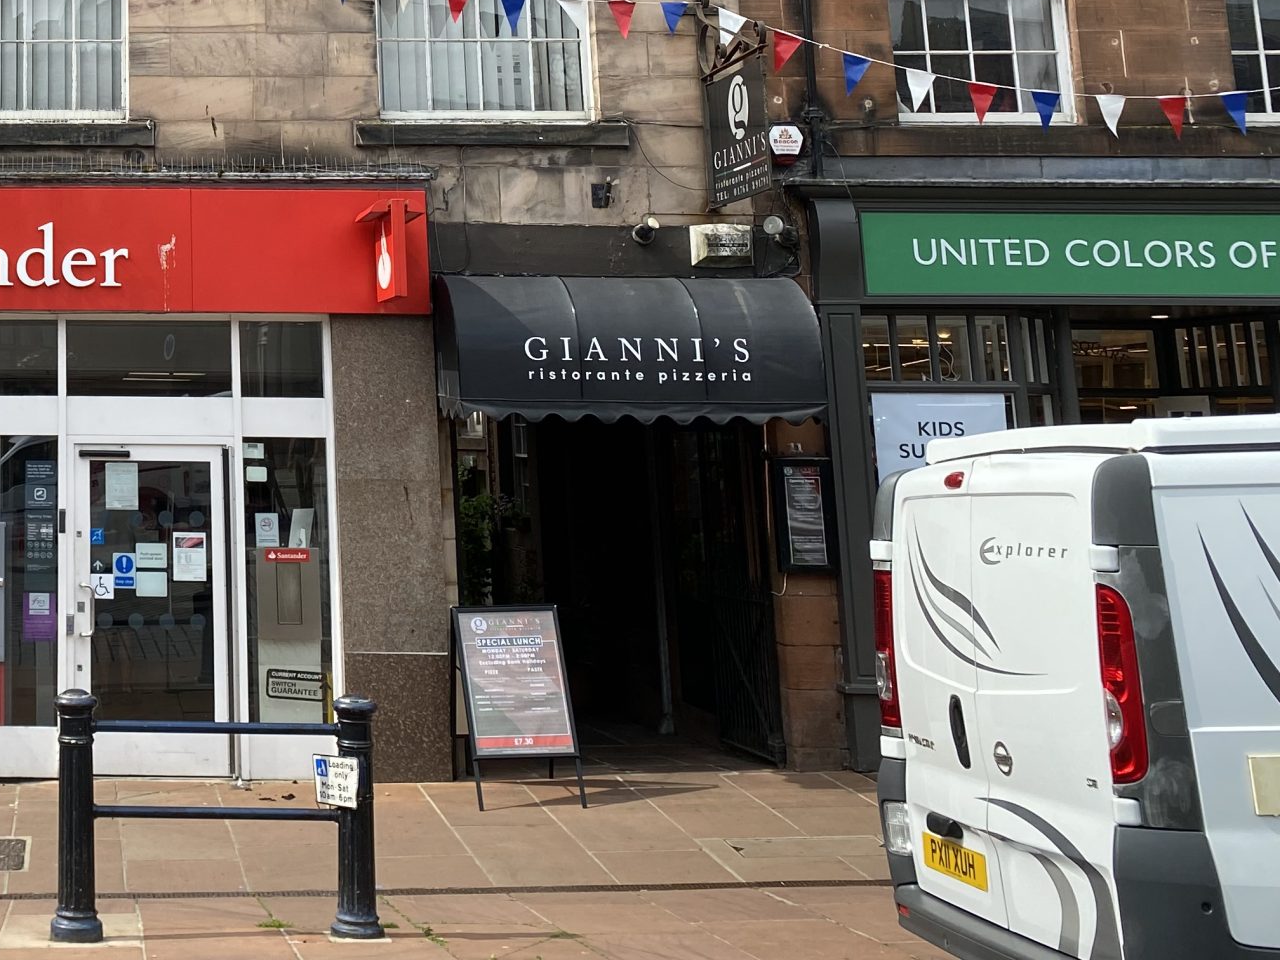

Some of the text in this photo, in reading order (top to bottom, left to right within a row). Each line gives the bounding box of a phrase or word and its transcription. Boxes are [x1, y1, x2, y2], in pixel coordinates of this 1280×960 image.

[714, 131, 767, 170] GIANNI'S
[912, 238, 1277, 269] UNITED COLORS OF
[524, 336, 750, 363] GIANNI'S
[528, 368, 752, 384] ristorante pizzeria
[917, 421, 965, 437] KIDS
[980, 536, 1068, 565] Explorer
[476, 637, 541, 646] SPECIAL LUNCH
[271, 680, 297, 688] SWITCH
[297, 672, 322, 680] ACCOUNT
[271, 687, 318, 696] GUARANTEE
[328, 759, 354, 771] Loading
[334, 771, 348, 781] only
[930, 838, 976, 880] PX11 XUH
